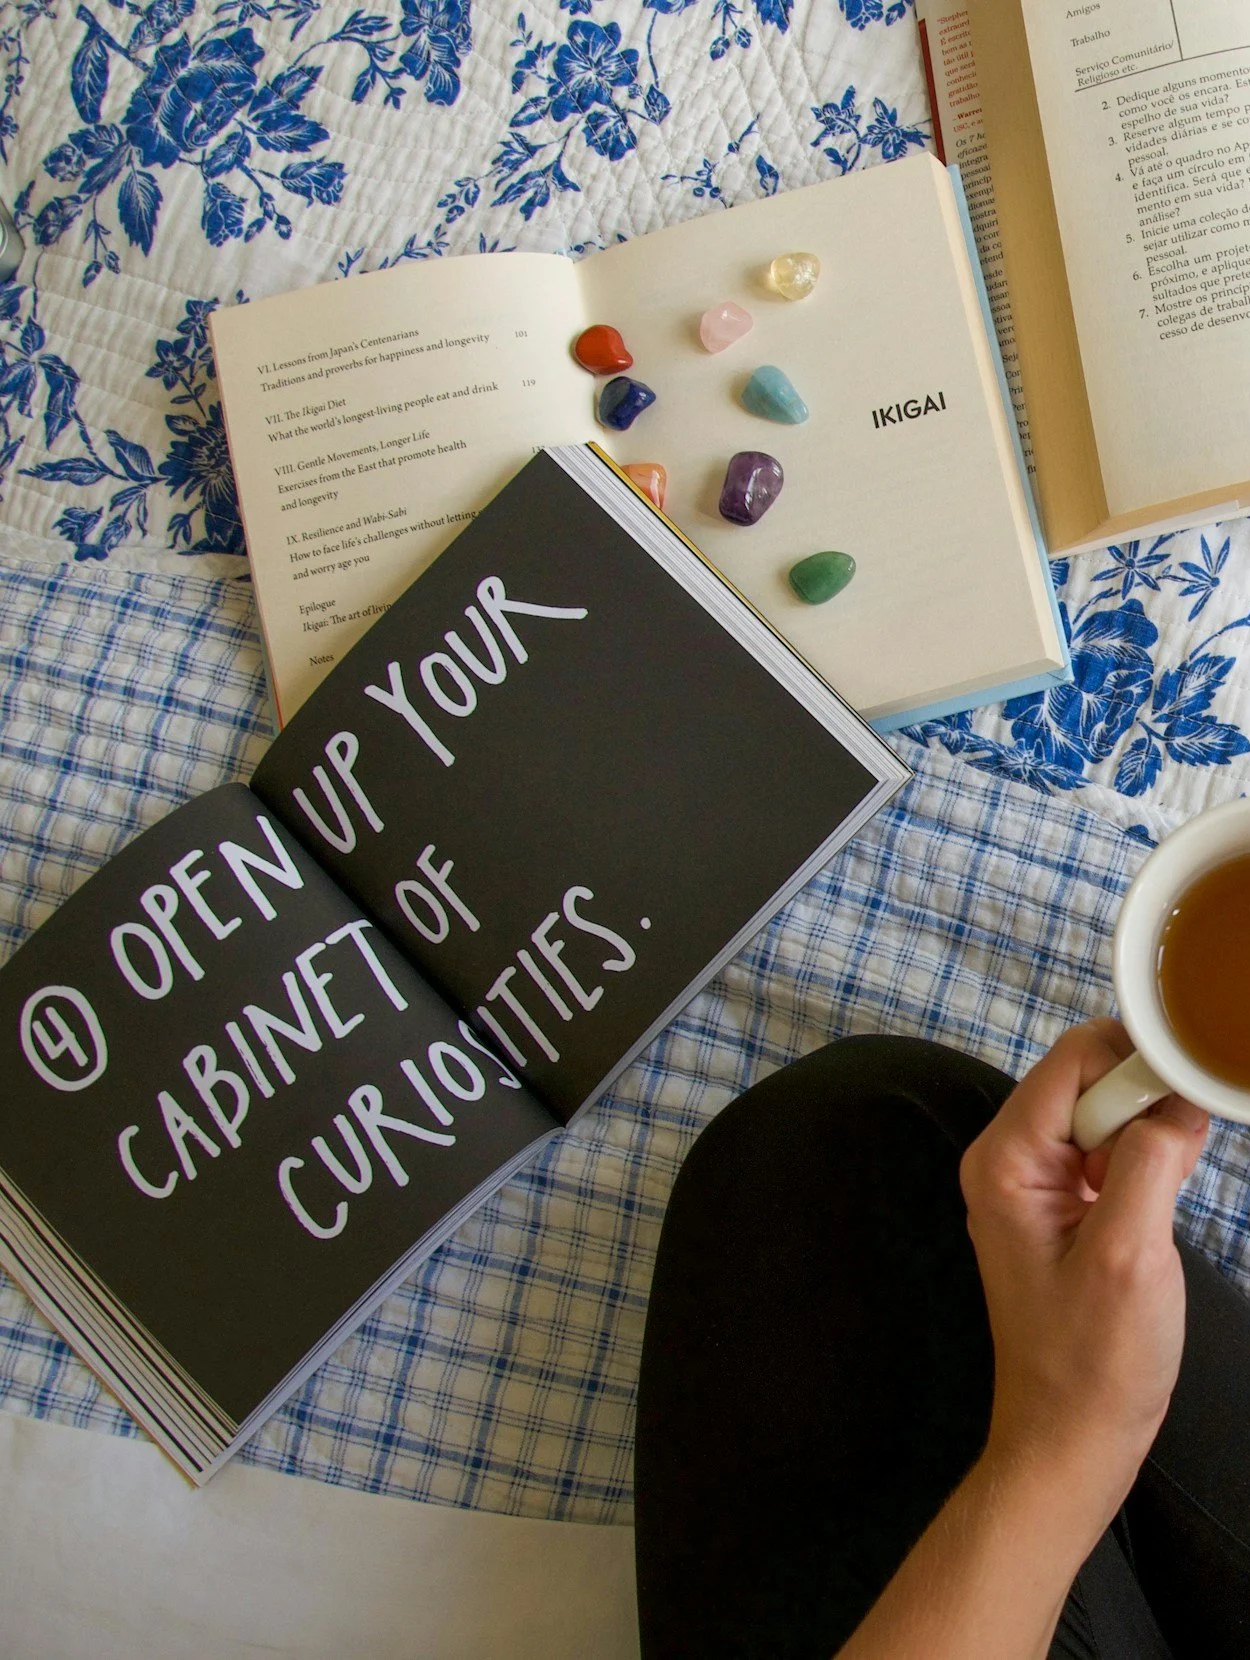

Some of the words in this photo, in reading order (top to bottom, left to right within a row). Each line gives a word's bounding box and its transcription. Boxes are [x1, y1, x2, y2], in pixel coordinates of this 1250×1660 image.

[1066, 3, 1101, 19] Amigos
[1070, 30, 1111, 47] Trabalho
[1075, 61, 1110, 76] Serviço
[1078, 69, 1120, 87] Religioso
[1122, 64, 1139, 74] etc.
[1101, 100, 1112, 111] 2.
[1116, 88, 1160, 106] Dedique
[1163, 78, 1197, 93] alguns
[1119, 104, 1148, 118] como
[1150, 94, 1174, 108] você
[1178, 92, 1190, 101] os
[1194, 84, 1232, 97] encara.
[1121, 112, 1161, 130] espelho
[1164, 108, 1177, 117] de
[1180, 103, 1198, 113] sua
[1201, 94, 1229, 108] vida?
[1139, 308, 1149, 319] 7.
[1154, 298, 1192, 314] Mostre
[1195, 294, 1208, 303] os
[1159, 327, 1188, 340] cesso
[1190, 321, 1204, 332] de
[260, 376, 306, 392] Traditions
[308, 368, 324, 380] and
[325, 359, 364, 378] proverbs
[364, 356, 377, 366] for
[378, 347, 424, 362] happiness
[426, 339, 444, 351] and
[445, 335, 490, 348] longevity
[272, 358, 306, 372] Lessons
[308, 352, 329, 362] from
[360, 330, 419, 349] Centenarians
[265, 414, 283, 425] VII.
[284, 410, 300, 420] The
[302, 405, 326, 416] Ikigai
[327, 399, 346, 410] Diet
[268, 430, 293, 442] What
[294, 426, 308, 436] the
[342, 404, 403, 424] longest-living
[404, 394, 434, 411] people
[436, 392, 450, 401] eat
[452, 386, 470, 398] and
[472, 382, 499, 394] drink
[872, 392, 946, 429] IKIGAI
[274, 464, 296, 476] VIII.
[297, 456, 325, 470] Gentle
[327, 445, 379, 463] Movements,
[380, 436, 410, 450] Longer
[412, 429, 430, 442] Life
[278, 479, 318, 494] Exercises
[319, 473, 340, 484] from
[341, 468, 356, 478] the
[358, 462, 376, 473] East
[378, 457, 396, 468] that
[398, 449, 436, 466] promote
[437, 440, 467, 454] health
[281, 499, 298, 512] and
[298, 491, 338, 507] longevity
[290, 552, 310, 563] How
[323, 544, 340, 554] face
[363, 528, 409, 544] challenges
[410, 517, 445, 532] without
[302, 525, 344, 541] Resilience
[346, 518, 362, 530] and
[363, 507, 407, 525] Wabi-Sabi
[293, 568, 309, 580] and
[310, 564, 336, 575] worry
[338, 560, 352, 570] age
[353, 556, 370, 567] you
[299, 600, 336, 616] Epilogue
[329, 614, 346, 624] The
[348, 610, 360, 620] art
[309, 654, 334, 666] Notes
[110, 815, 303, 999] OPEN
[292, 731, 384, 854] UP
[365, 575, 588, 767] YOUR
[118, 918, 408, 1198] CABINET
[394, 844, 480, 944] OF
